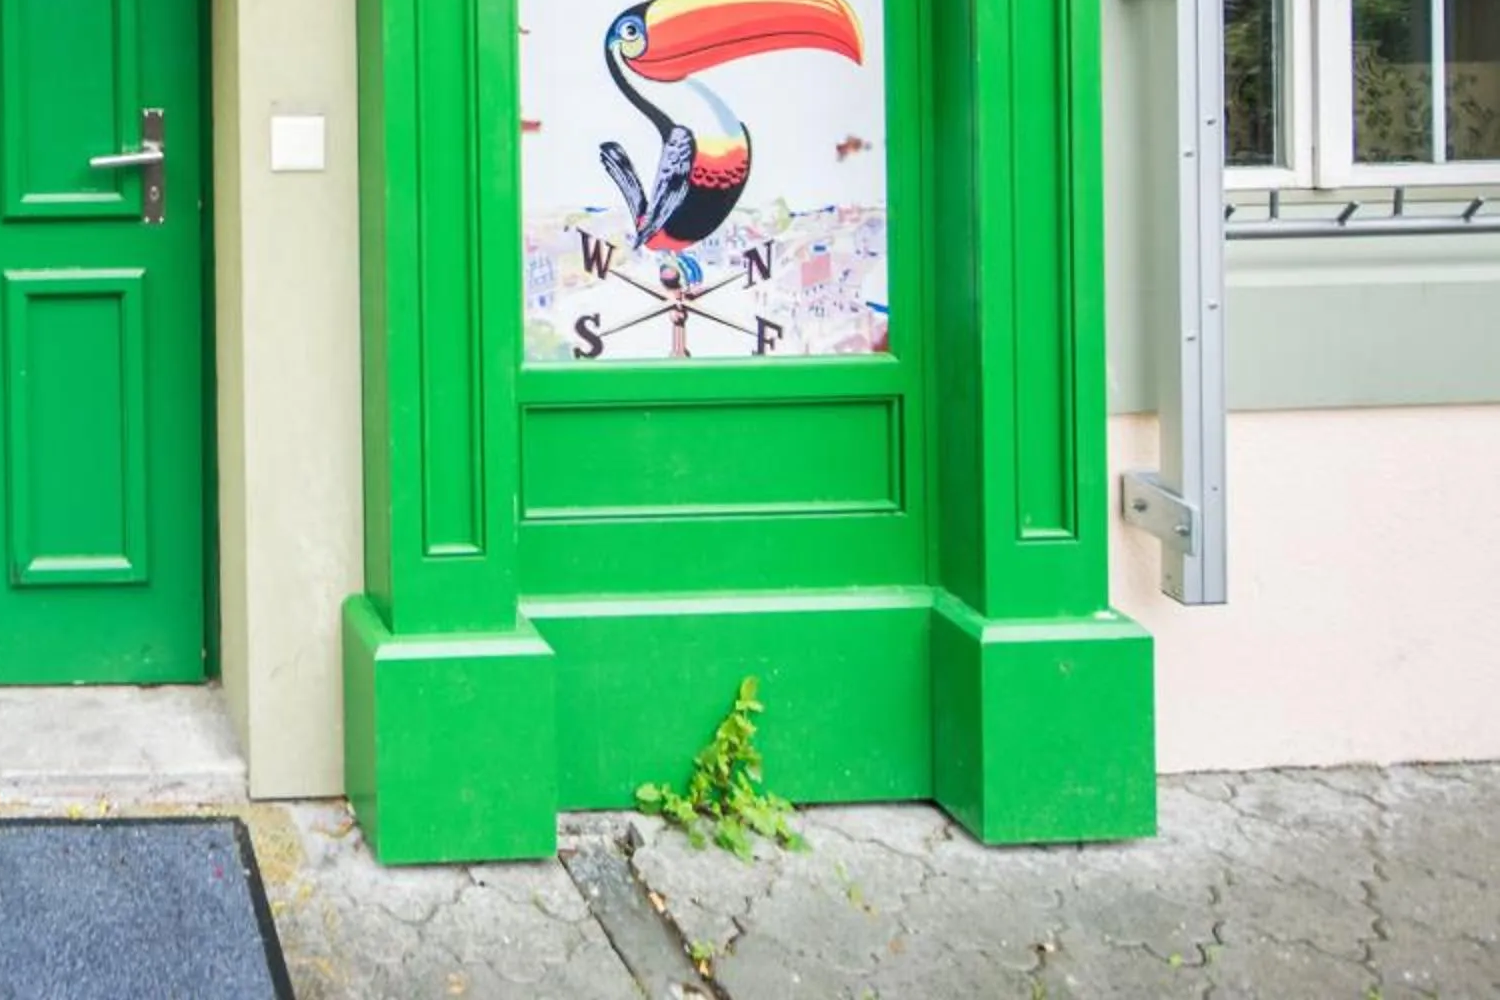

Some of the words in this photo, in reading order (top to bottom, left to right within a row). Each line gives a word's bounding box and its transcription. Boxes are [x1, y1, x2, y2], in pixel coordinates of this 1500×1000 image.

[576, 227, 617, 280] W
[743, 239, 775, 290] N
[573, 312, 606, 360] S
